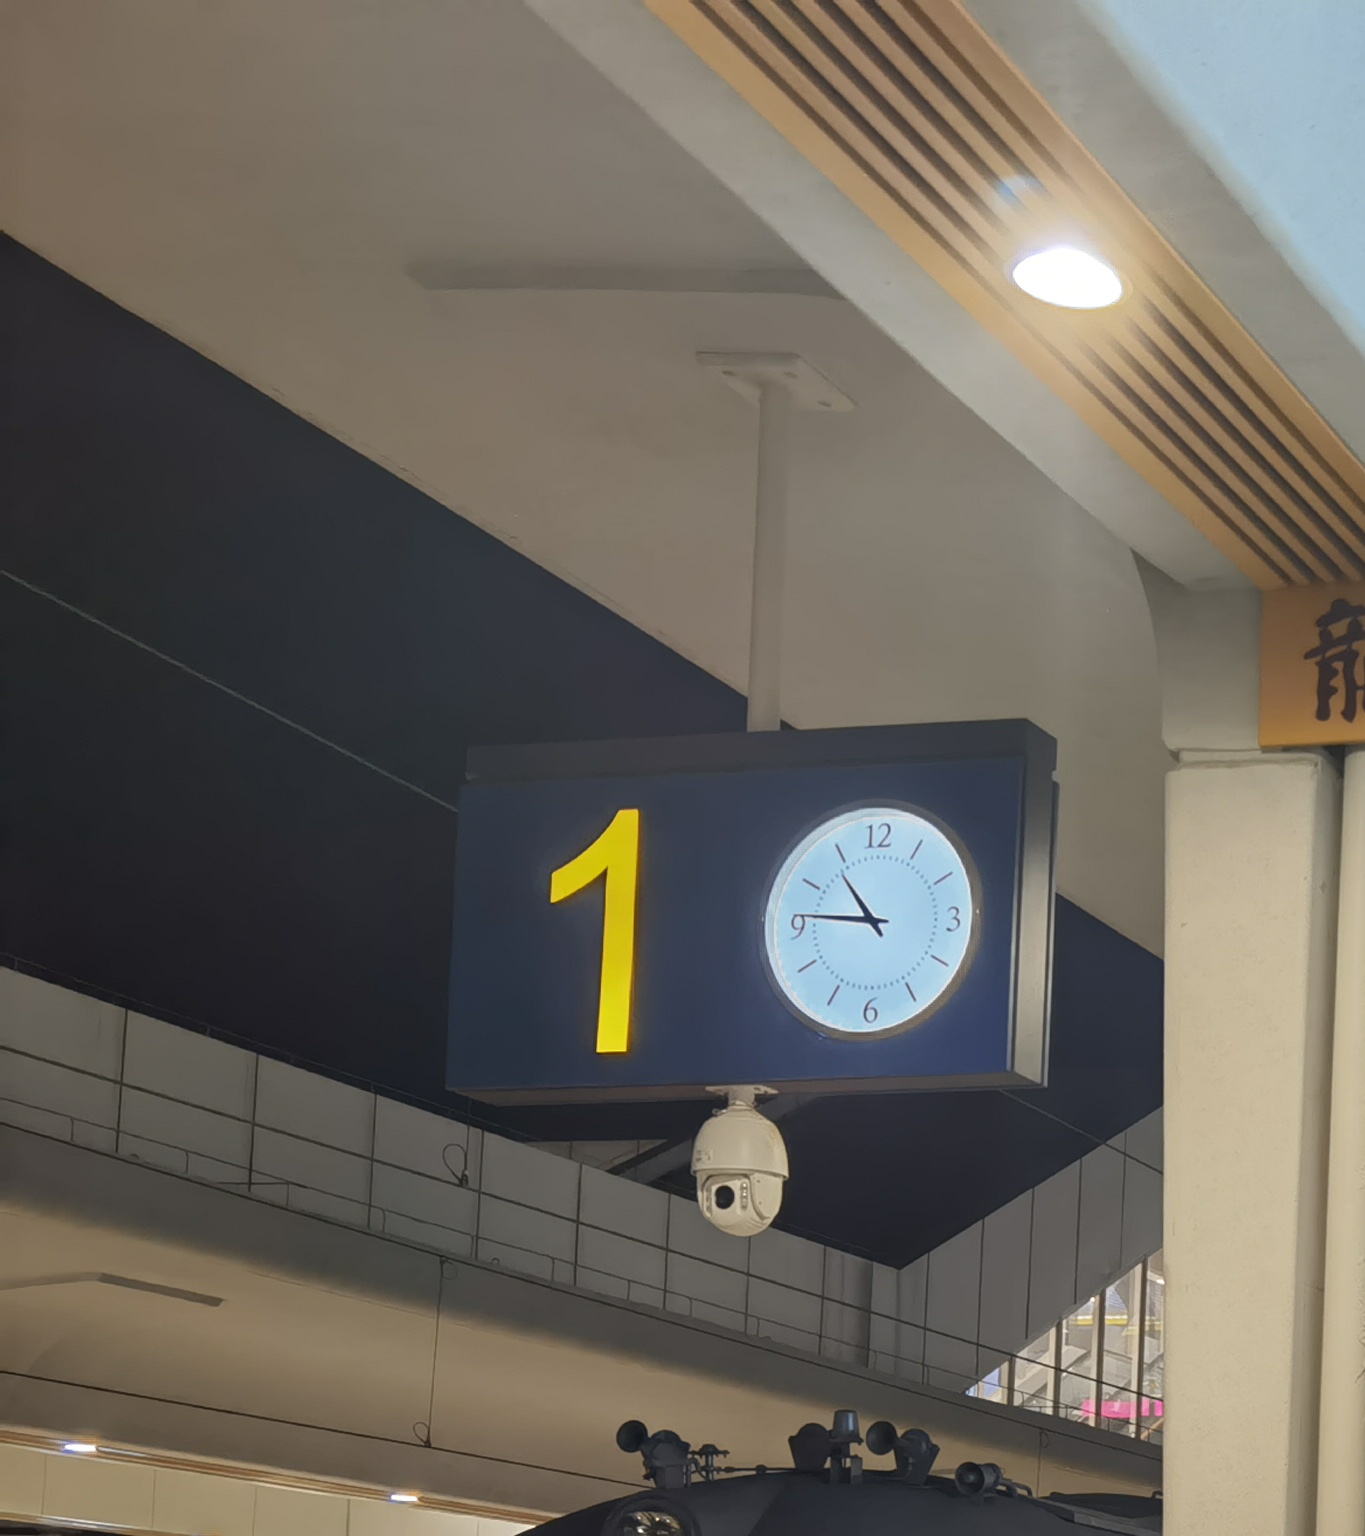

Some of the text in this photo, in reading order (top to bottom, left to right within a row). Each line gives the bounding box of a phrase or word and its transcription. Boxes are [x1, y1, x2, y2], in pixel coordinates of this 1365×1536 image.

[865, 822, 893, 849] 12
[551, 808, 639, 1053] 1
[790, 914, 807, 940] 9
[946, 905, 962, 933] 3
[862, 997, 879, 1023] 6
